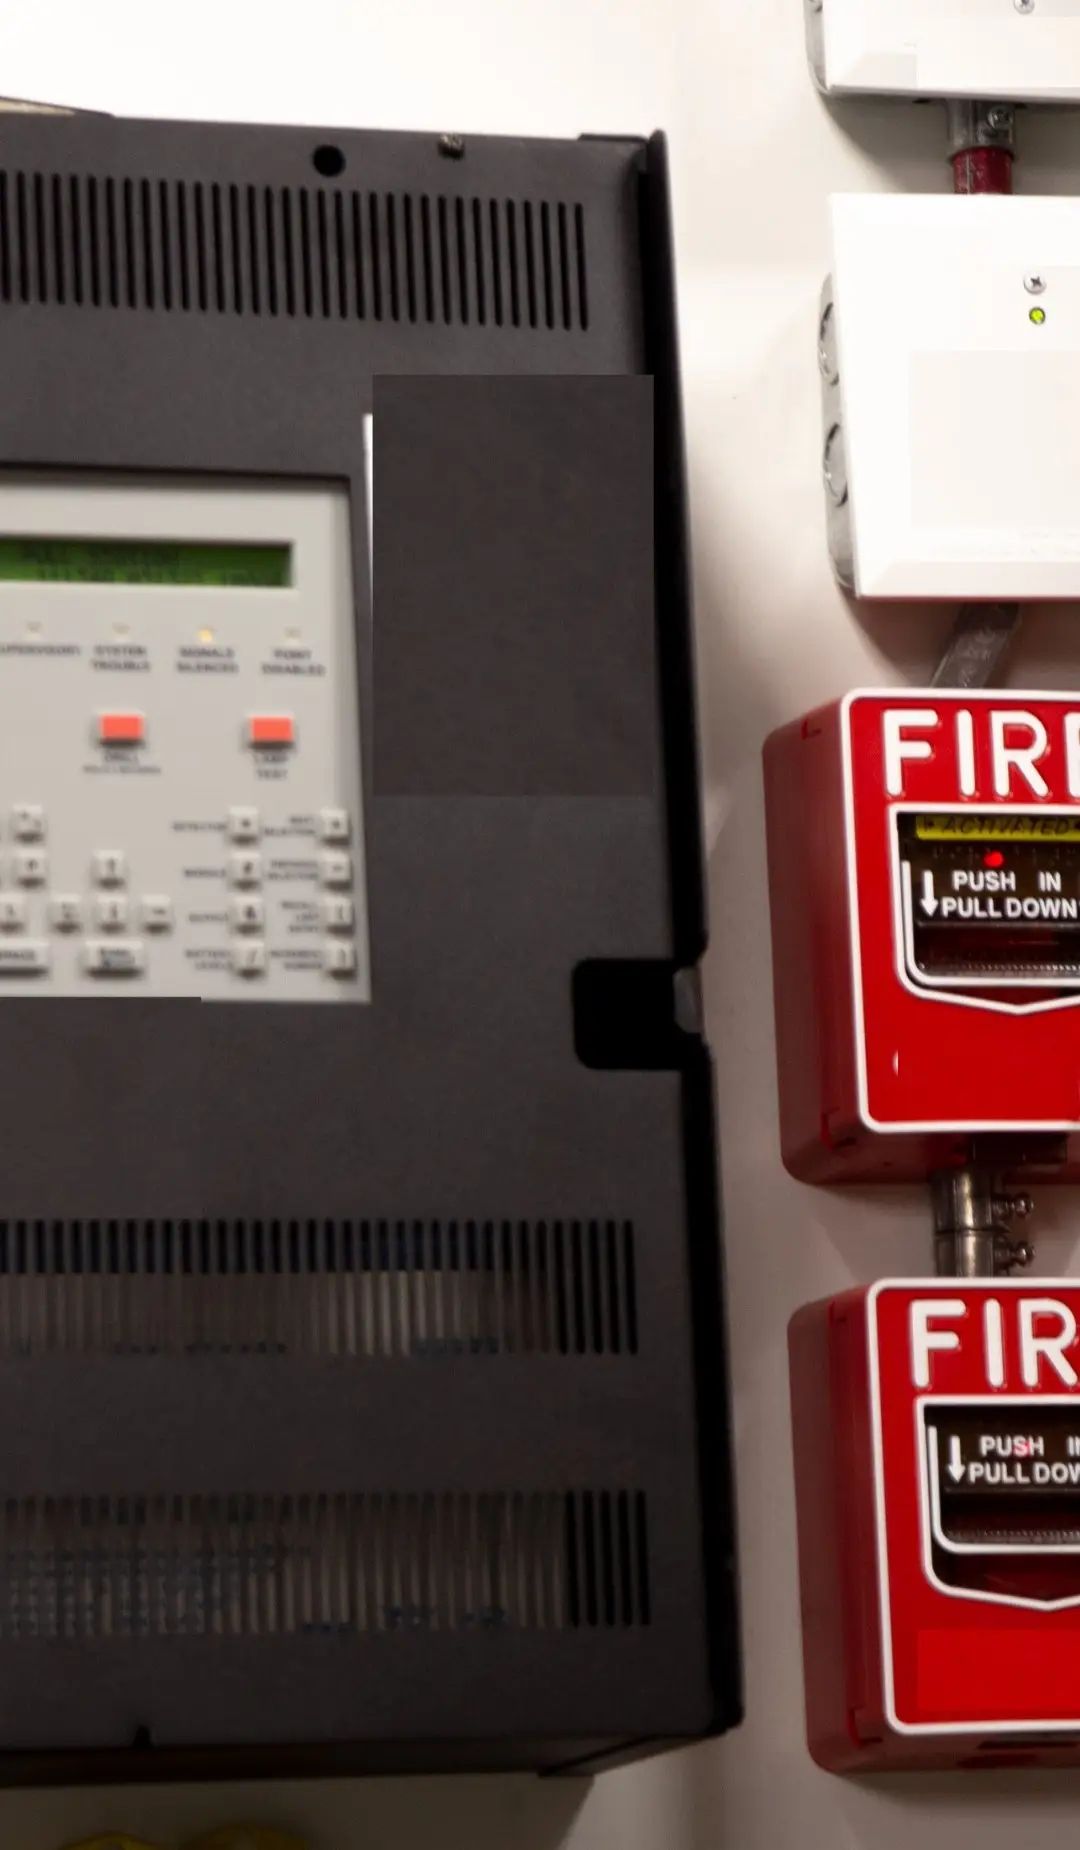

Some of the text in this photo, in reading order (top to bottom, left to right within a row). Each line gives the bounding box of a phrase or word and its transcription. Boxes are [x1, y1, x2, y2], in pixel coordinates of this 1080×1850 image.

[941, 815, 1070, 836] ACTIVATED
[952, 869, 1063, 893] PUSH IN
[941, 896, 1077, 919] PULL DOWN
[979, 1435, 1045, 1458] PUSH
[968, 1462, 1031, 1484] PULL
